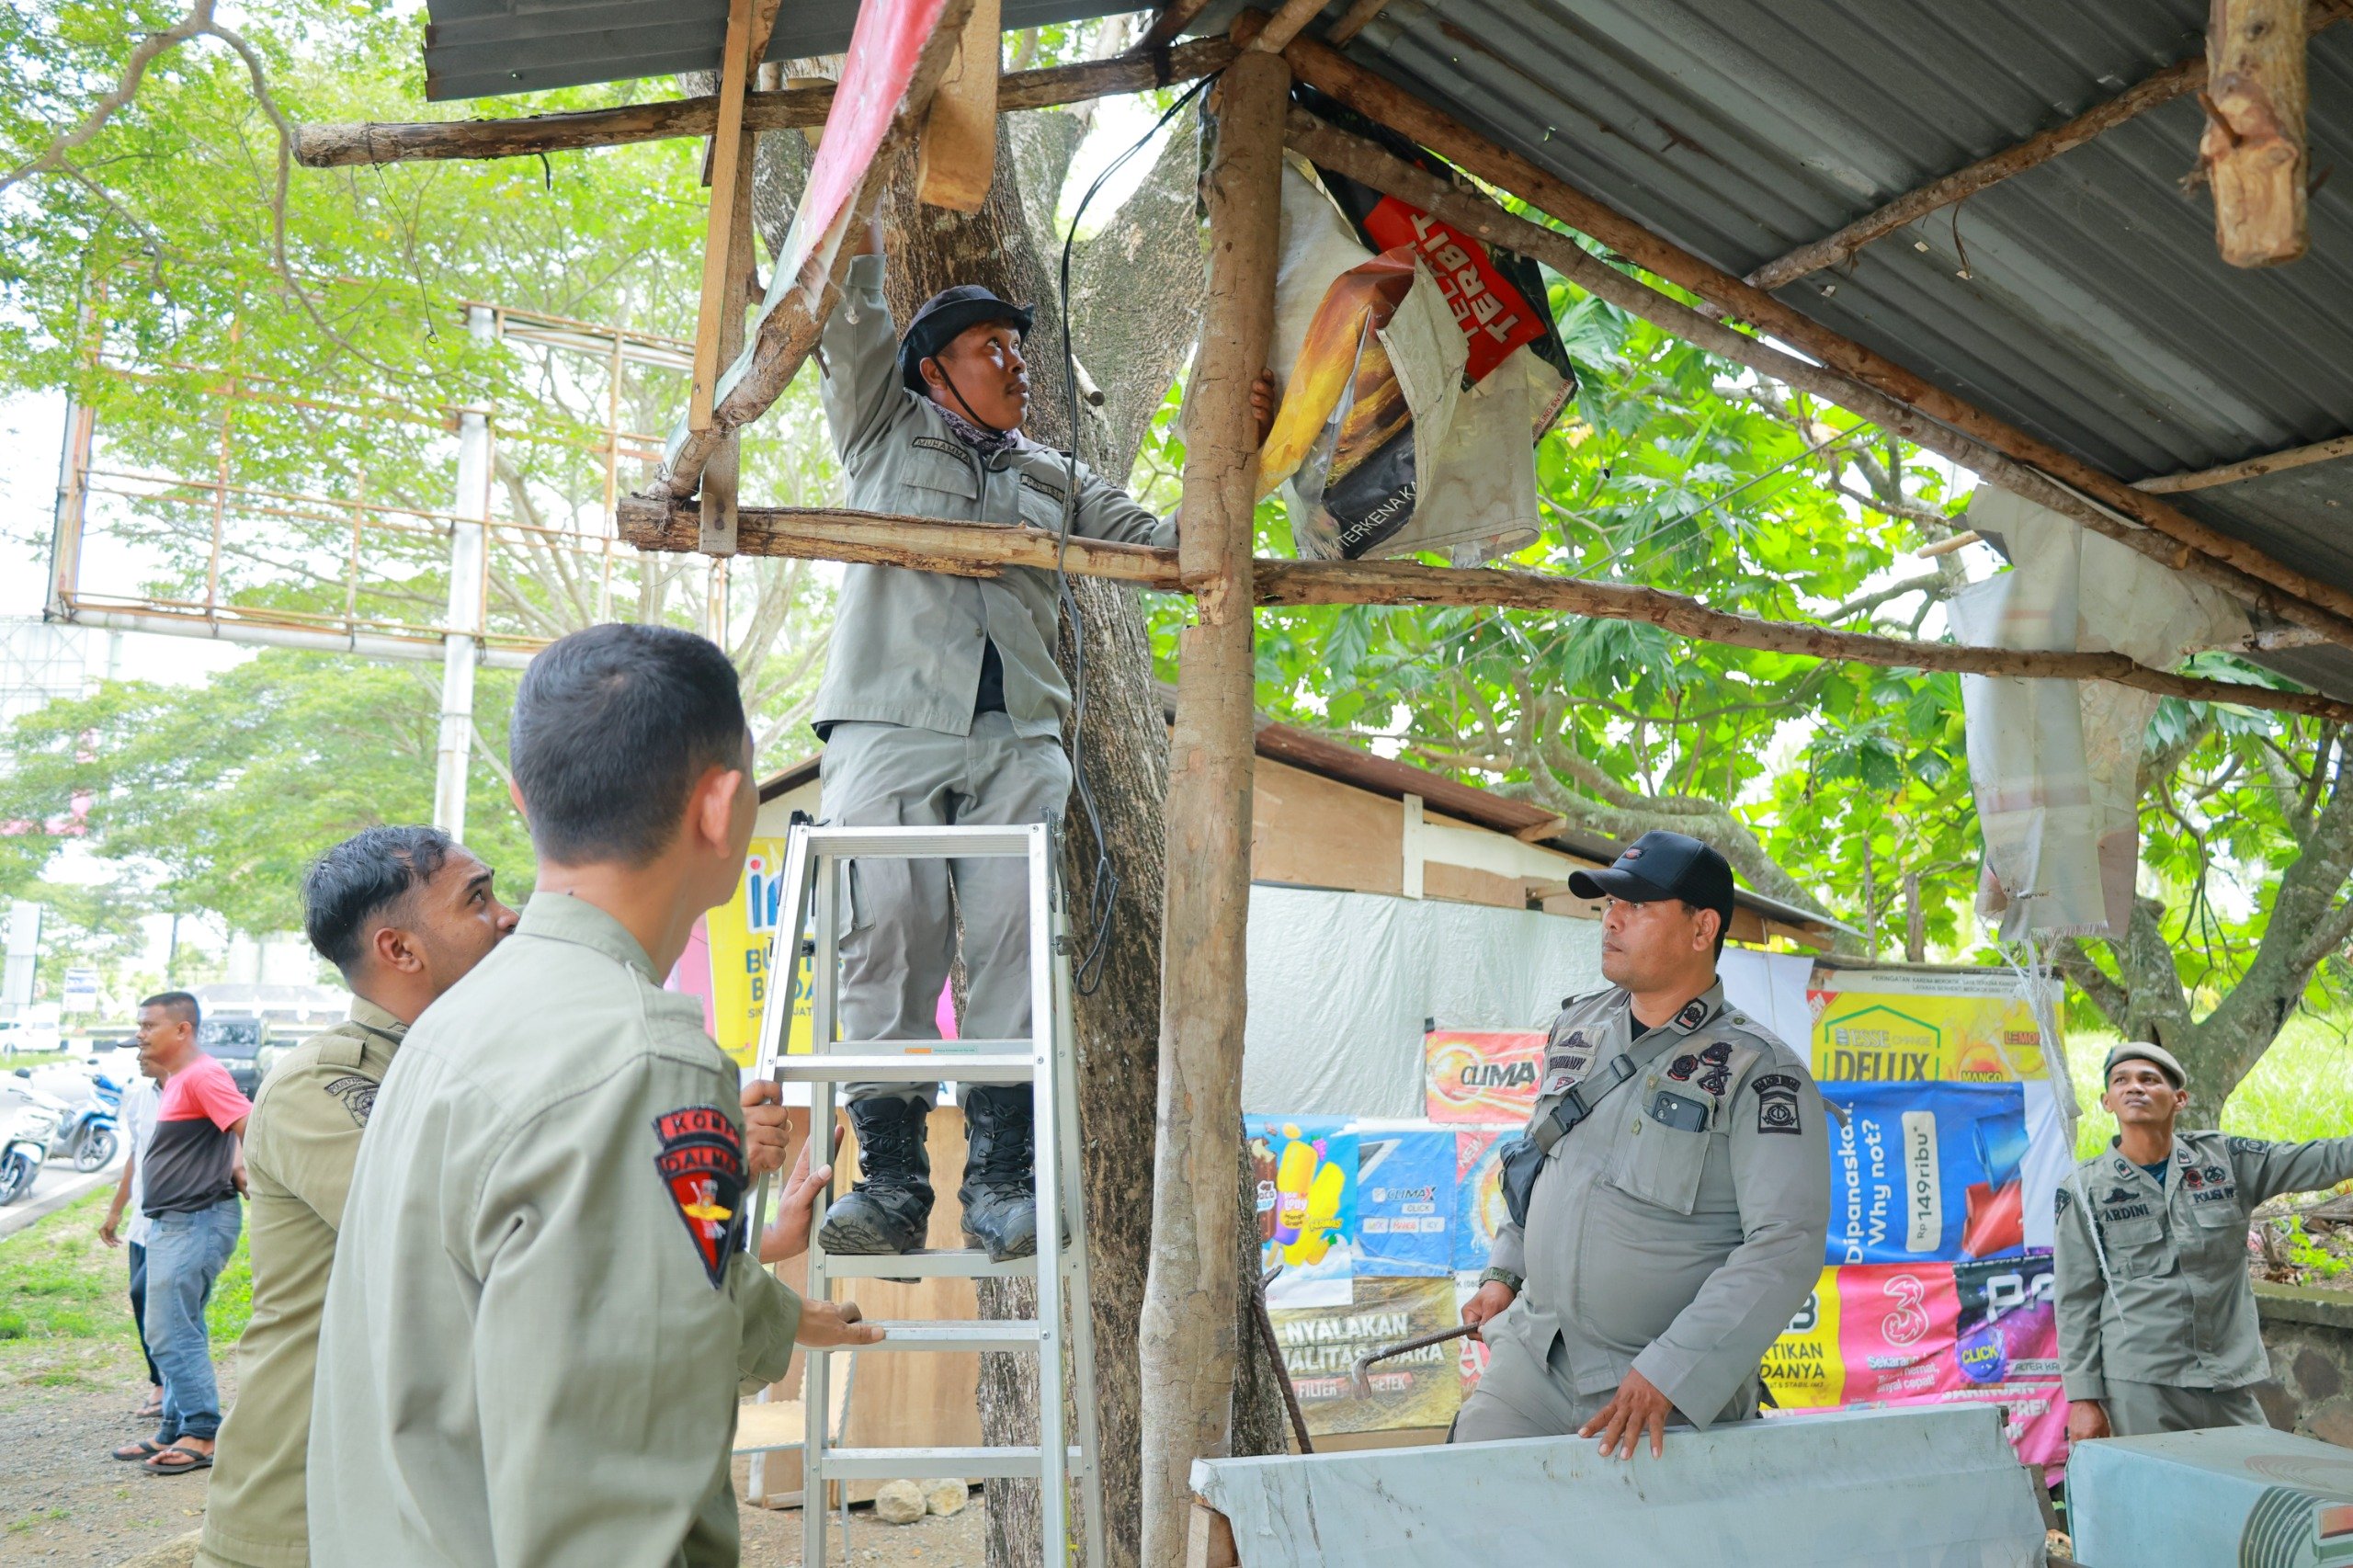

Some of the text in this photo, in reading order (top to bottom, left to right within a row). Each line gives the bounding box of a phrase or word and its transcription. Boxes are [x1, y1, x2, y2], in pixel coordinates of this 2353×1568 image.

[1410, 213, 1519, 343] TERBIT
[1336, 497, 1406, 547] TERKENA
[1850, 1028, 1890, 1047] ESSE
[1458, 1135, 1484, 1169] NEW
[1861, 1119, 1892, 1246] Why not?
[1387, 1187, 1437, 1202] CLIMAX
[1406, 1204, 1430, 1213] CLICK
[2105, 1203, 2150, 1222] ARDINI
[1881, 1274, 1929, 1347] 3
[1286, 1314, 1408, 1343] NYALAKAN
[1763, 1342, 1824, 1360] TIKAN
[1961, 1345, 1999, 1365] CLICK
[1298, 1379, 1336, 1398] FILTER
[1903, 1374, 1935, 1391] cepat!
